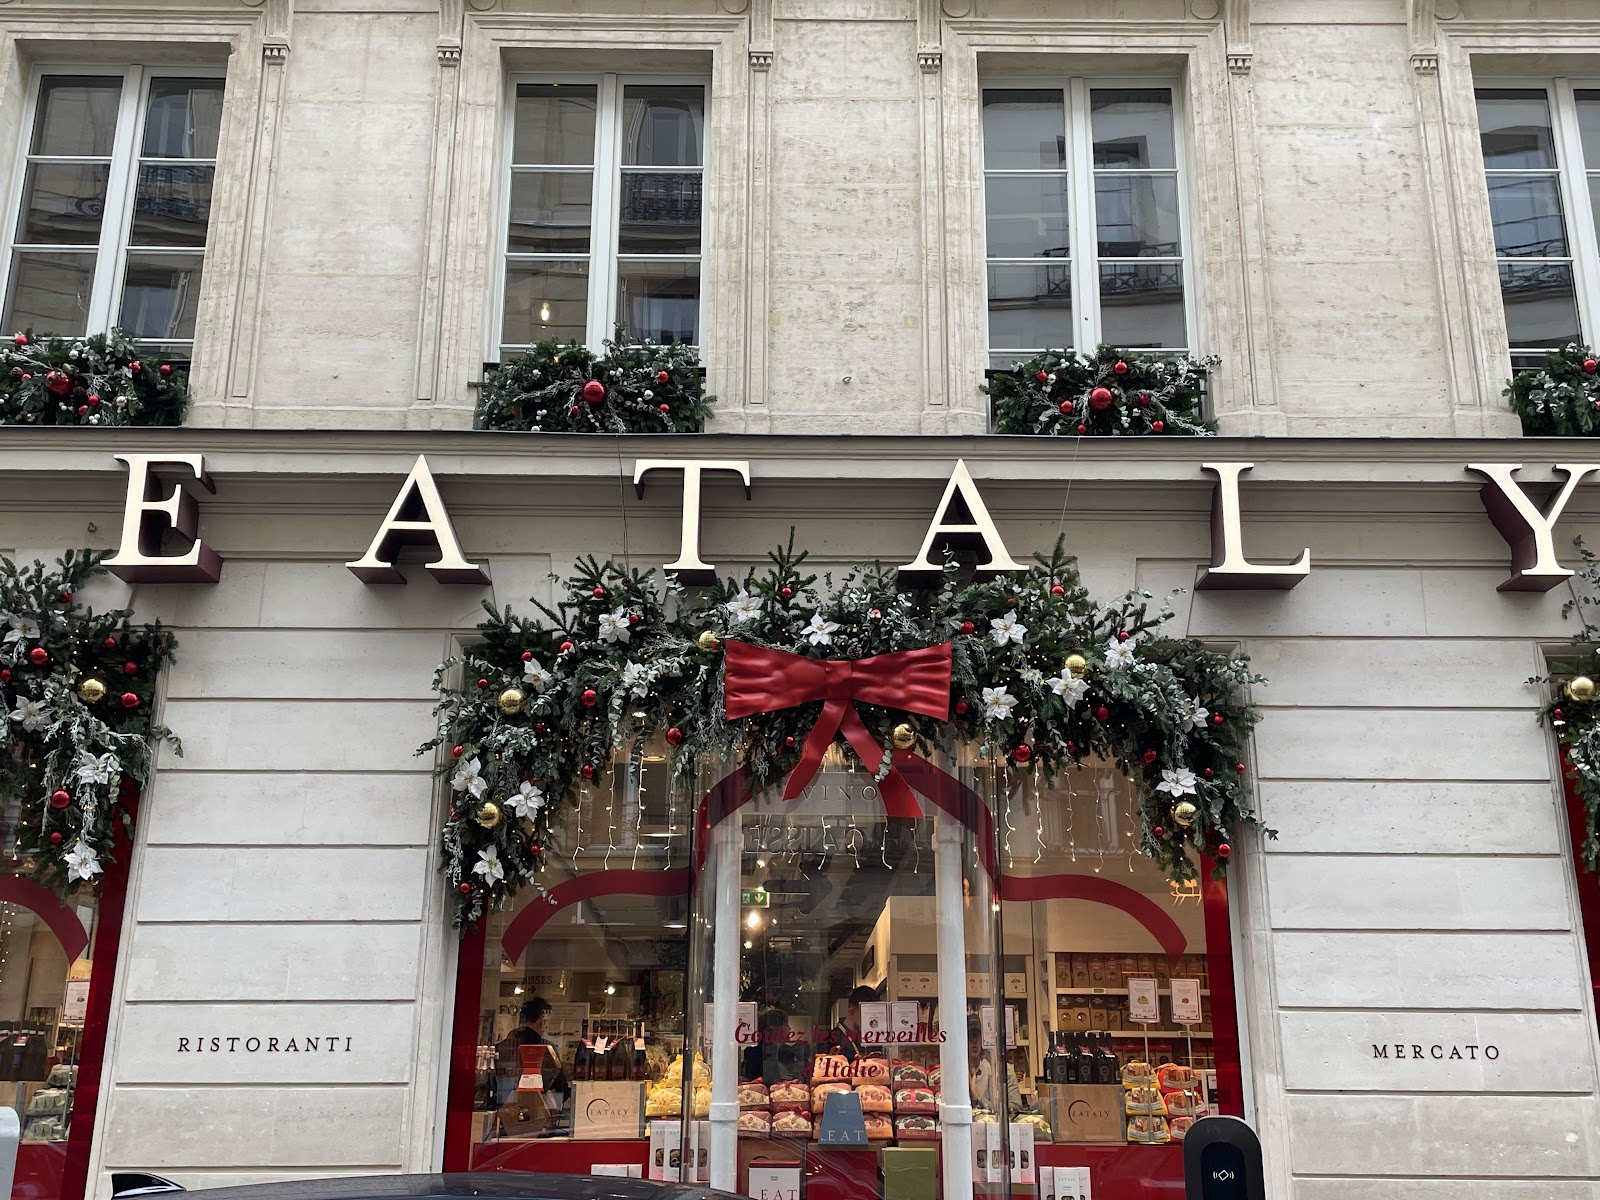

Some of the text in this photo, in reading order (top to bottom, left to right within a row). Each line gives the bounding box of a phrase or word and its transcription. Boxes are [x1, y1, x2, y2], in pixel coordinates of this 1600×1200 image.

[101, 452, 1600, 580] EATALY
[801, 785, 878, 801] VINO
[813, 1023, 838, 1044] les
[844, 1022, 948, 1044] merveilles
[177, 1036, 353, 1053] RISTORANTI
[1372, 1044, 1501, 1060] MERCATO
[590, 1108, 630, 1116] EATALY
